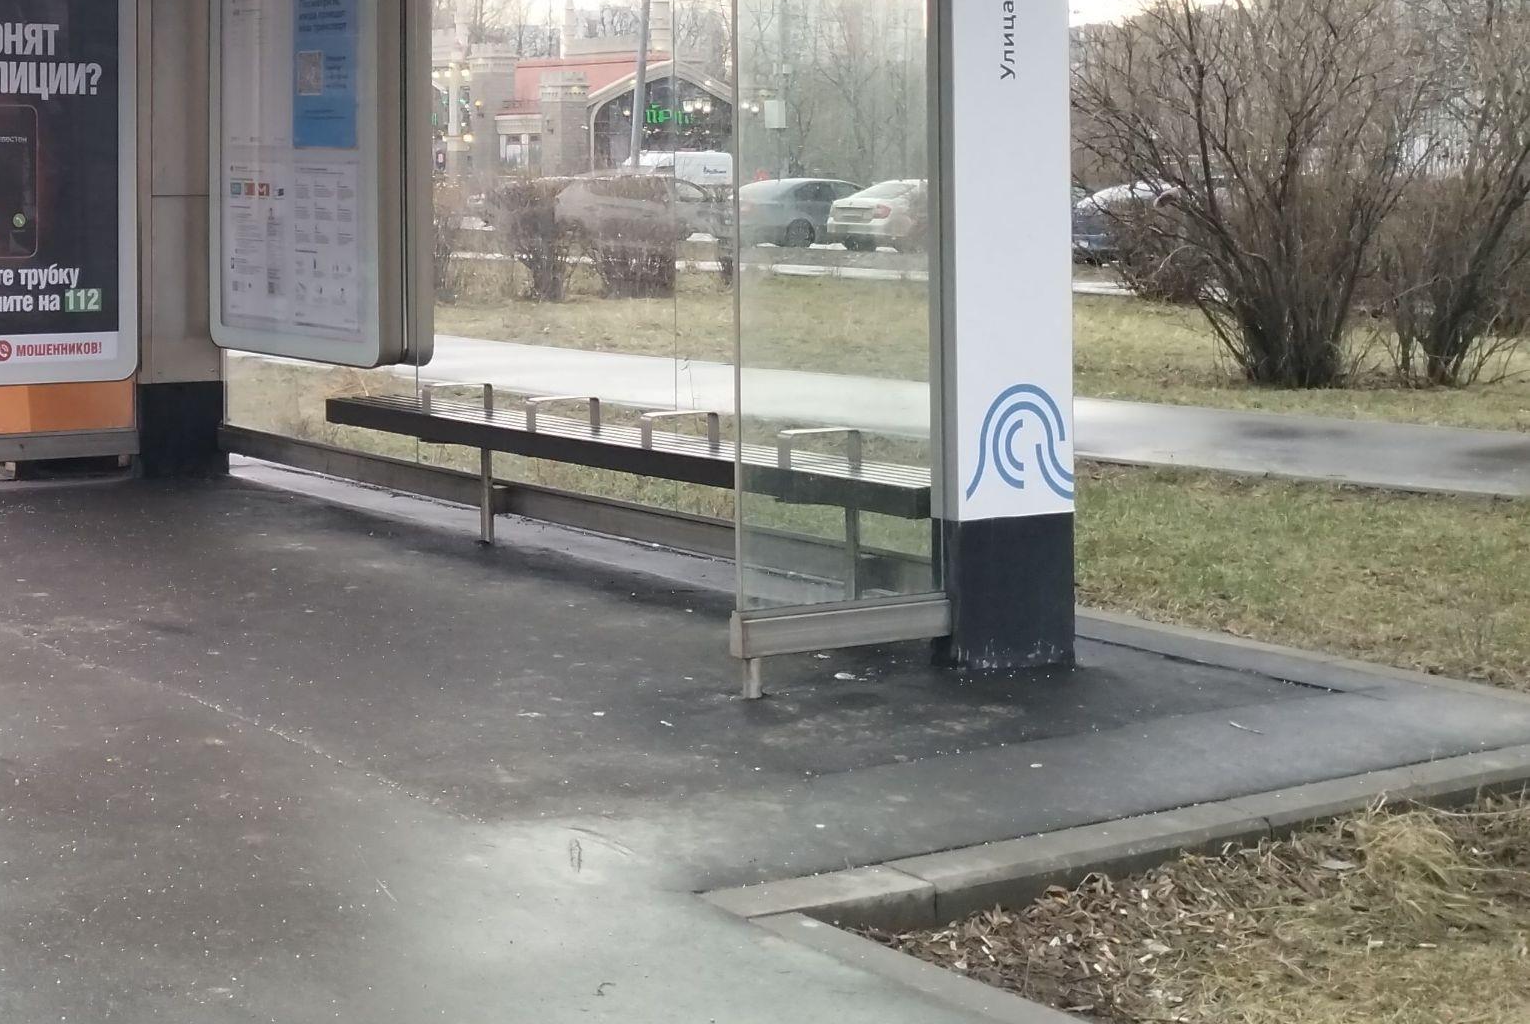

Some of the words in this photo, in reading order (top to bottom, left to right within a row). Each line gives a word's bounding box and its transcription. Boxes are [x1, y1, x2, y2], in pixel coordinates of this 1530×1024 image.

[1000, 0, 1016, 80] Улица
[18, 263, 80, 290] трубку
[38, 292, 61, 312] на
[65, 288, 100, 310] 112
[16, 341, 103, 357] МОШЕННИКОВ!
